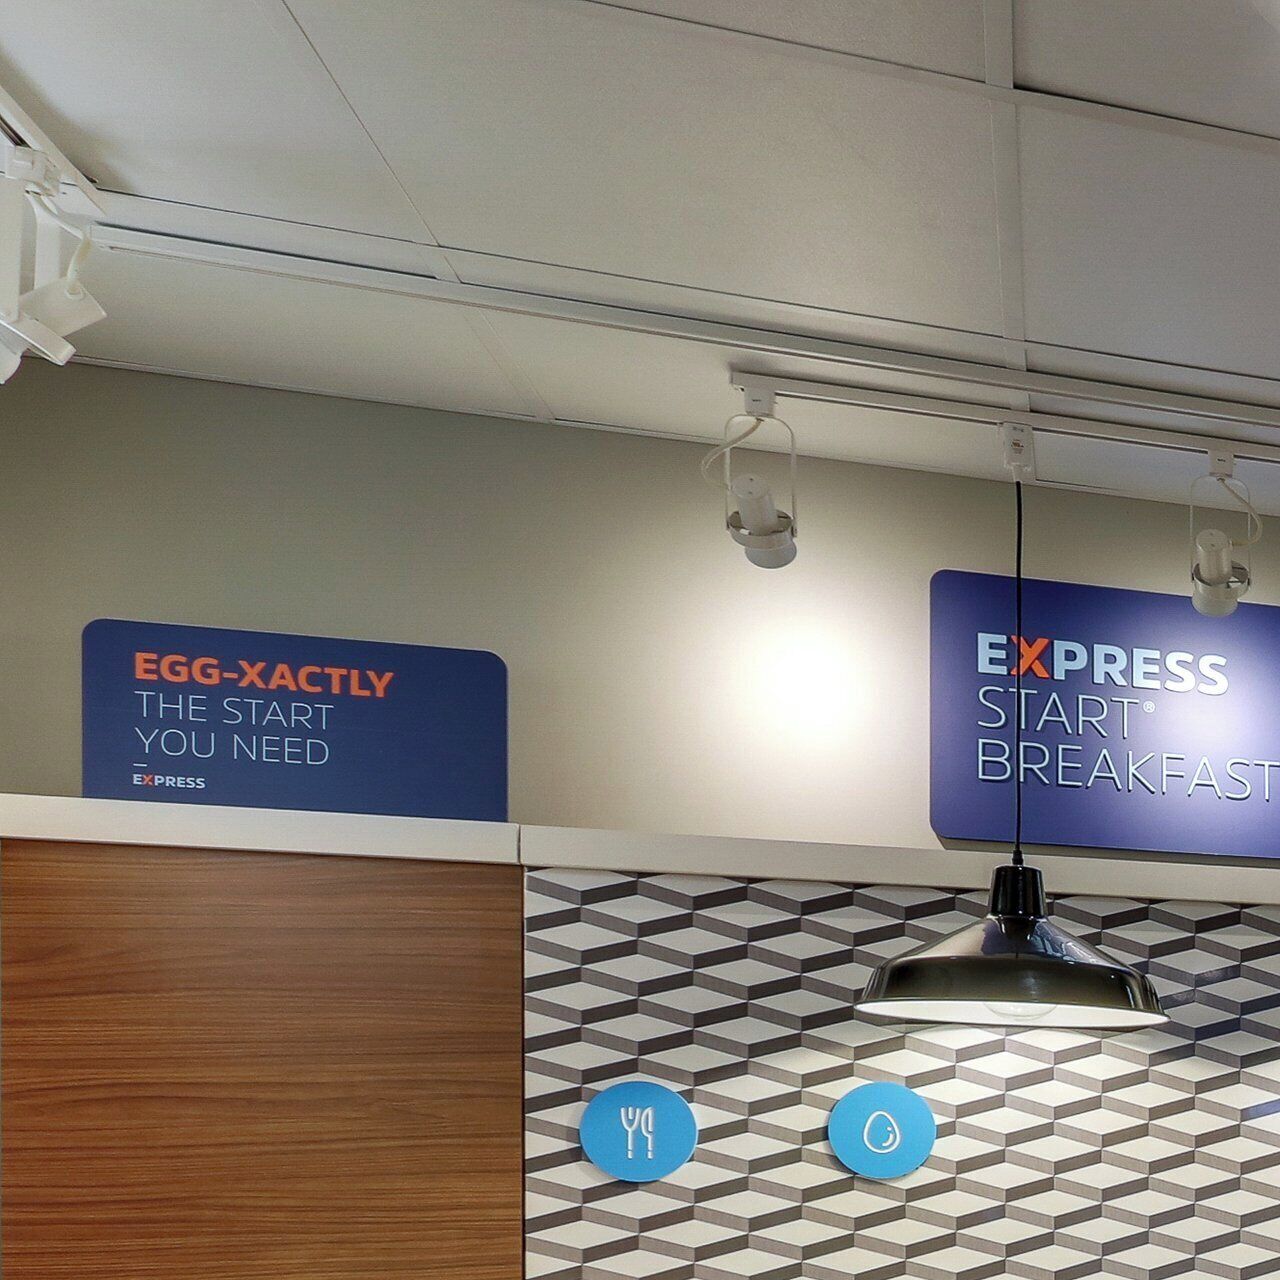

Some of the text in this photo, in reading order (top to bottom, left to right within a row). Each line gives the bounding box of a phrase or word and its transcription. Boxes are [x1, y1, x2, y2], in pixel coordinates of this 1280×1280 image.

[134, 651, 393, 698] EGG-XACTLY
[977, 631, 1230, 697] EXPRESS
[134, 690, 335, 731] THE START
[135, 726, 330, 766] YOU NEED
[133, 773, 206, 790] EXPRESS
